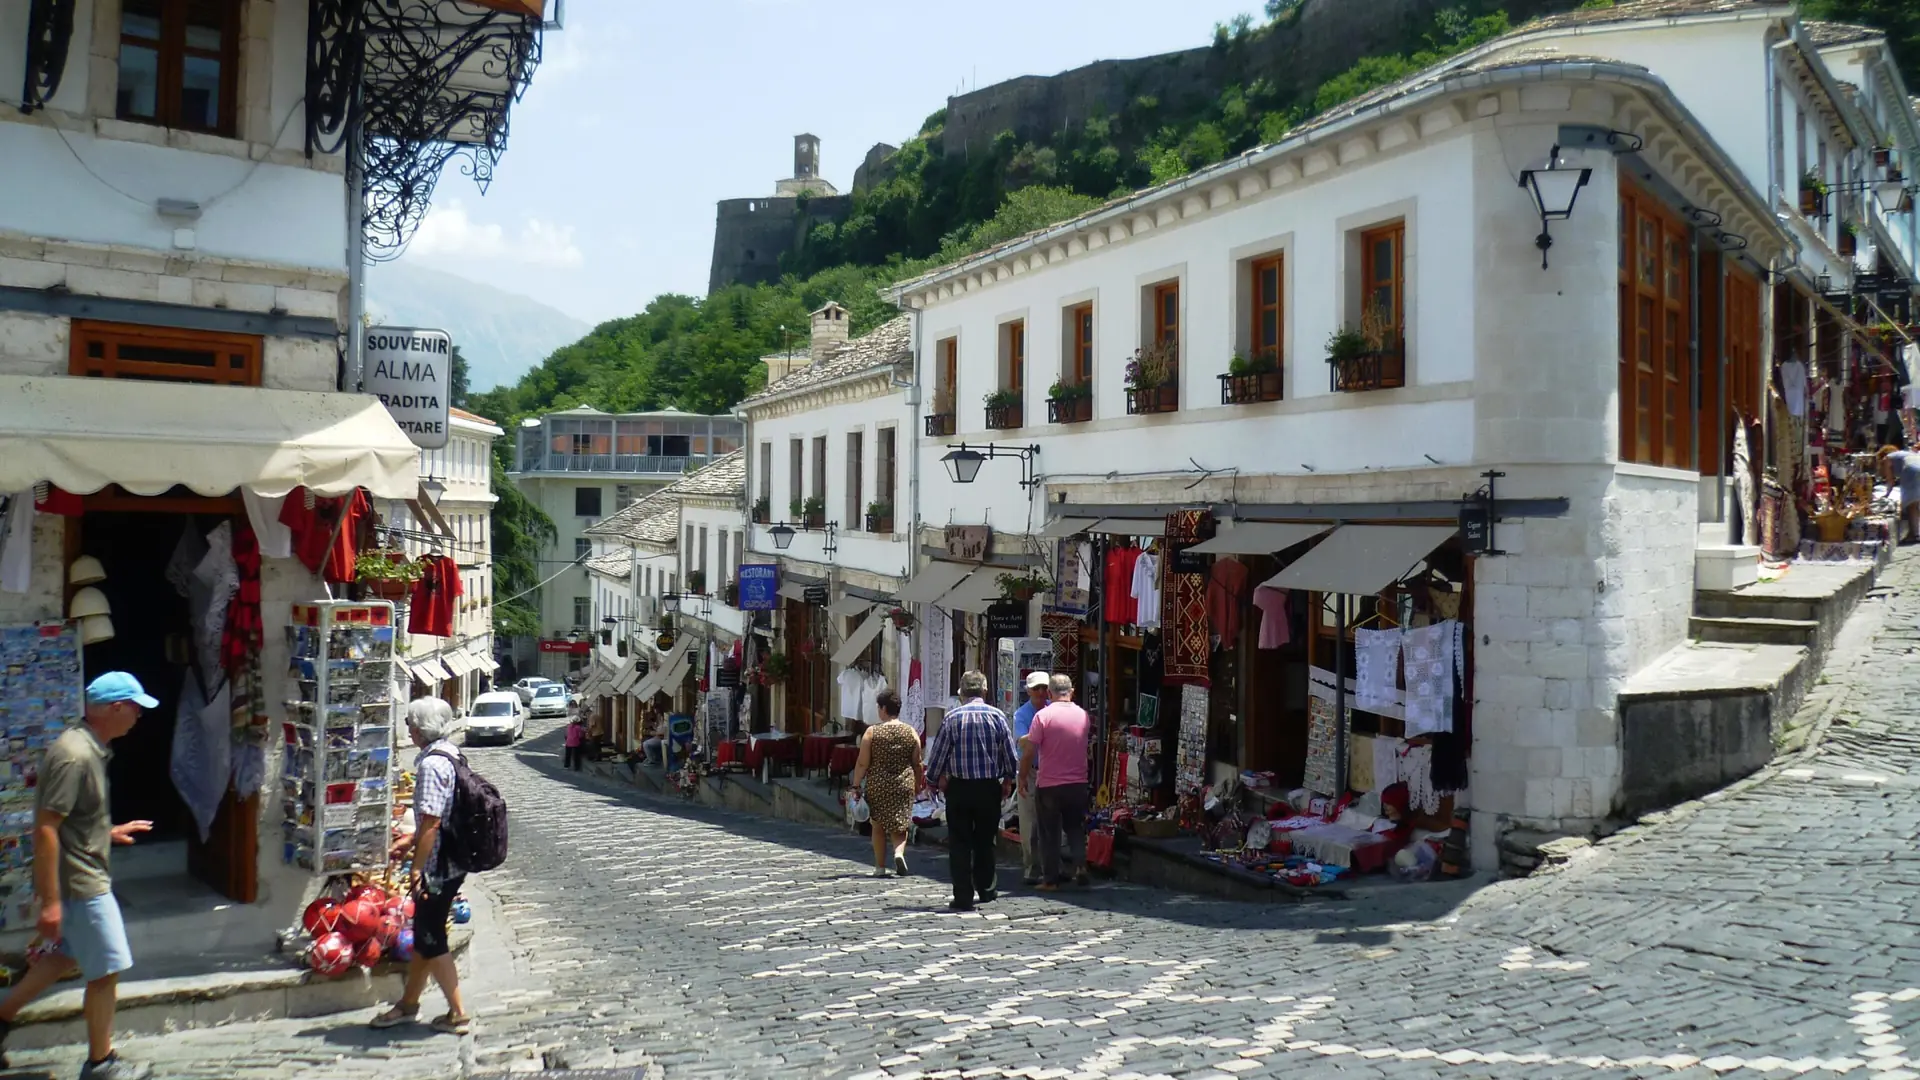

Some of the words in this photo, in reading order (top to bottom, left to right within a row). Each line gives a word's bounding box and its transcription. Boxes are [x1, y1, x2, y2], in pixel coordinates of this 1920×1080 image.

[367, 335, 448, 354] SOUVENIR
[374, 360, 436, 382] ALMA
[371, 393, 440, 409] RADITA
